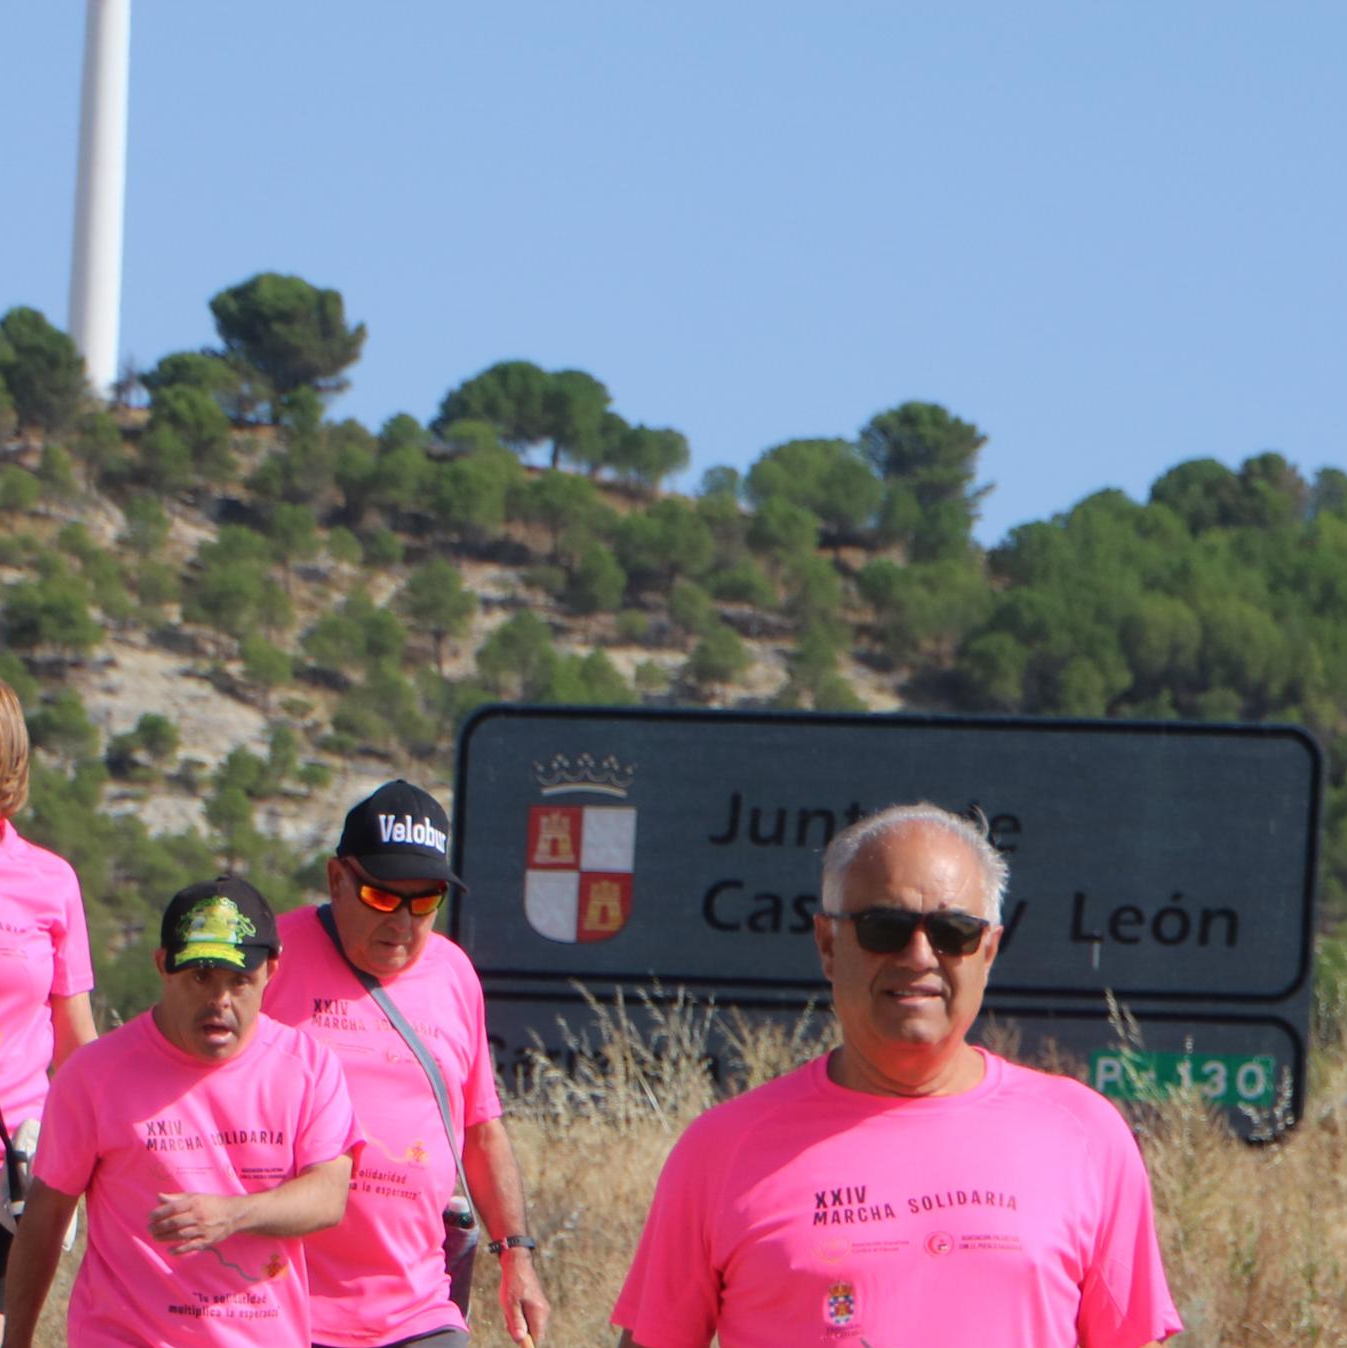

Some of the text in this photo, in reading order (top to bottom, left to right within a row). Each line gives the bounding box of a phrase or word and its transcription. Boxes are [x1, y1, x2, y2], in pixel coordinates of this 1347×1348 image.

[1070, 891, 1240, 948] León
[313, 998, 349, 1016] XXIV
[311, 1013, 366, 1032] MARCHA
[146, 1119, 182, 1136] XXIV
[146, 1136, 203, 1151] MARCHA
[815, 1185, 867, 1210] XXIV
[812, 1189, 1018, 1227] MARCHA SOLIDARIA
